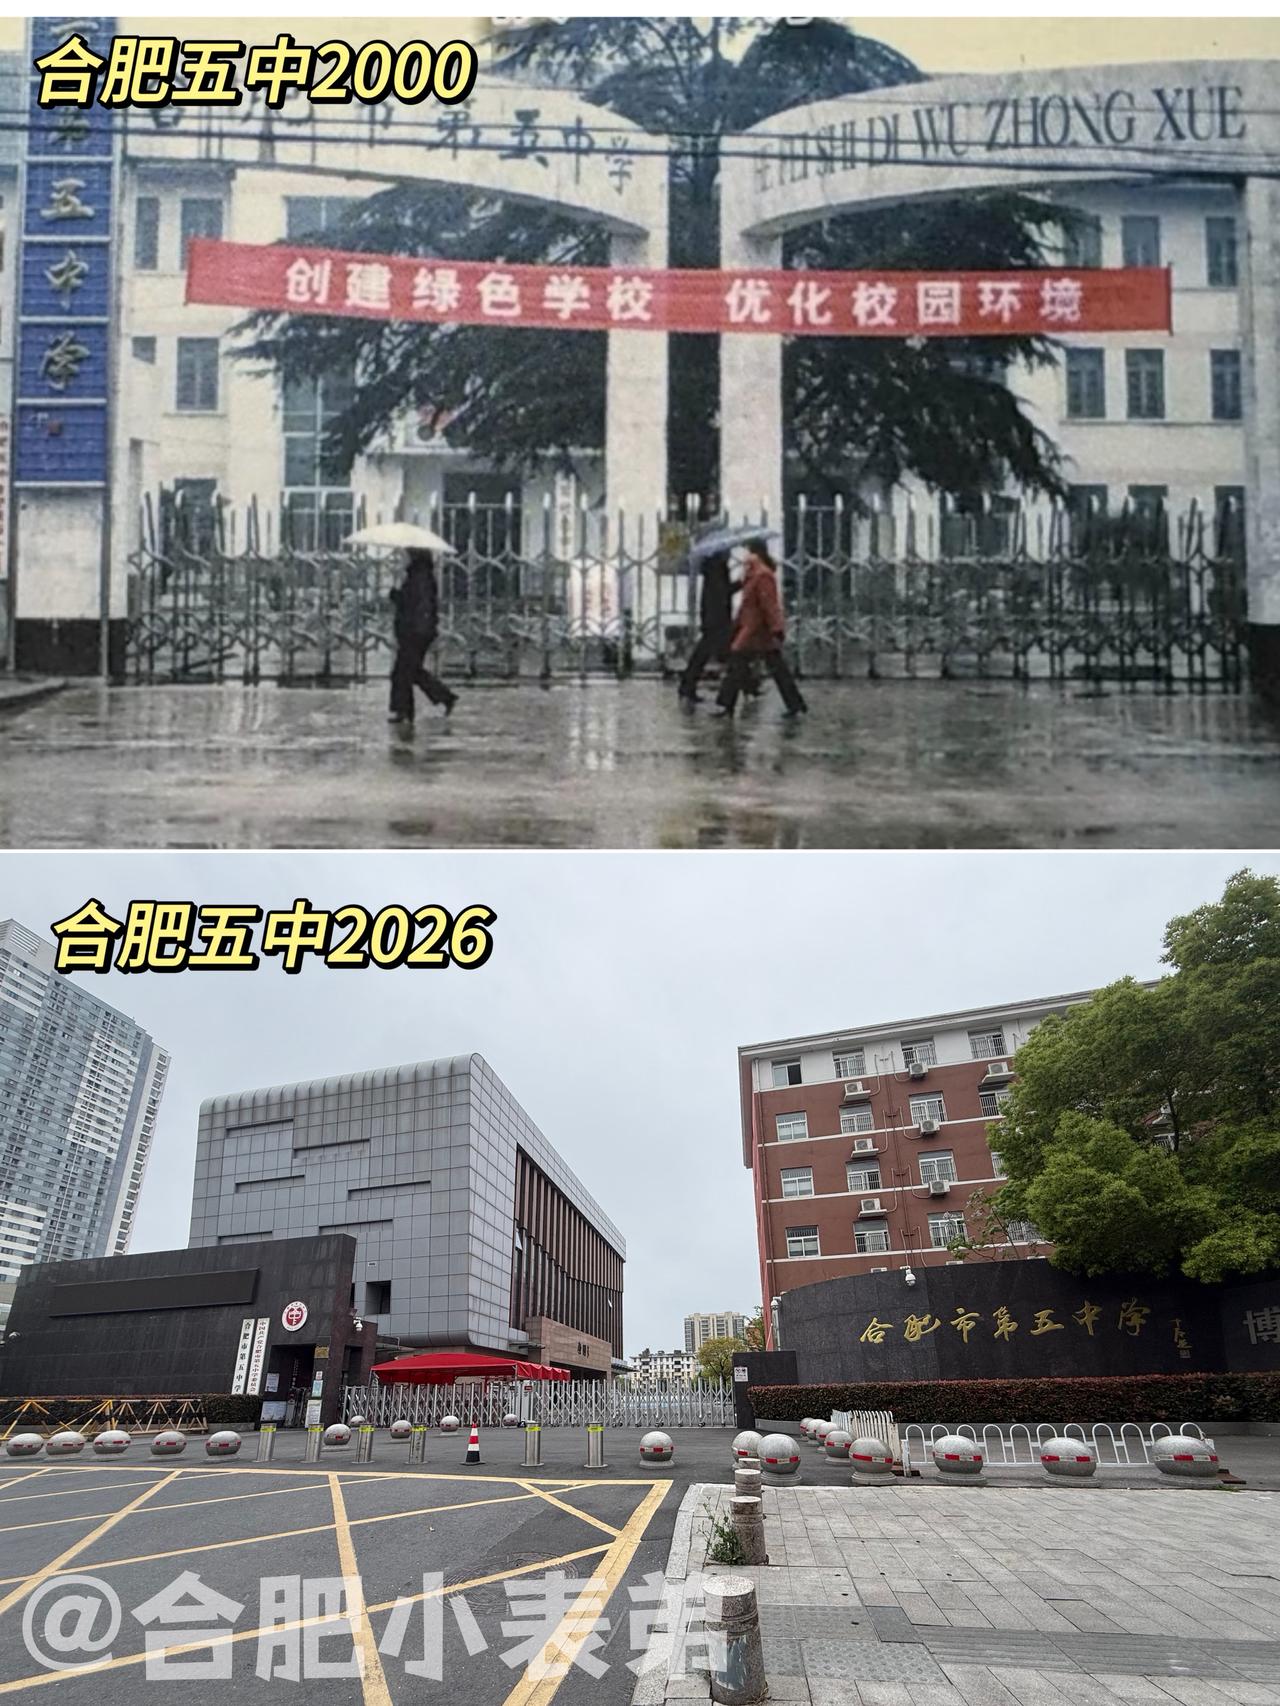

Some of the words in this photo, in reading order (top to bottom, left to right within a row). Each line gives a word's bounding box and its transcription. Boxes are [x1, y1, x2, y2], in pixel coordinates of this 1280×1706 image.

[913, 103, 972, 158] WU
[984, 90, 1137, 151] ZHONG
[1152, 85, 1247, 142] XUE
[285, 257, 653, 321] 创建绿色学校
[725, 278, 1083, 326] 优化校园环境
[234, 1321, 252, 1392] 合肥市第五中学
[860, 1298, 1151, 1345] 合肥市第五中学
